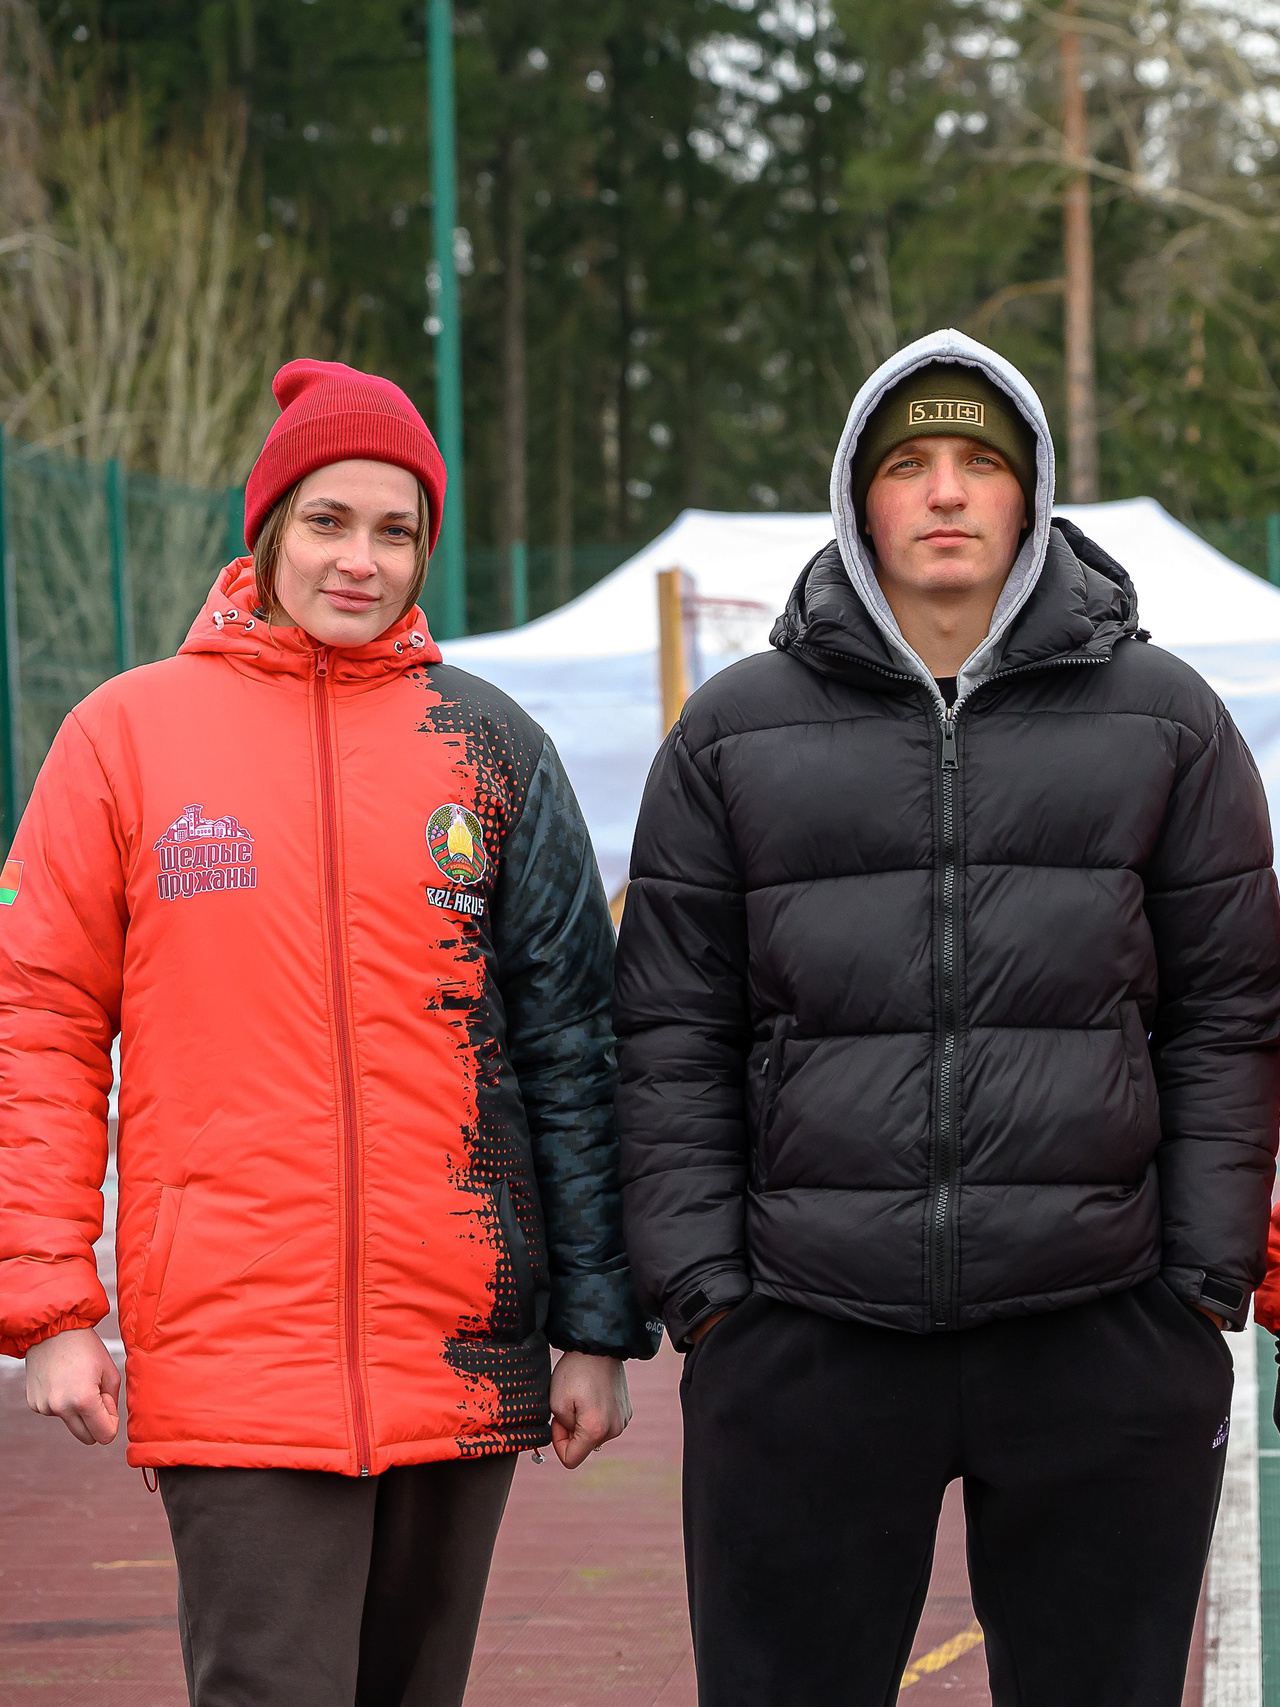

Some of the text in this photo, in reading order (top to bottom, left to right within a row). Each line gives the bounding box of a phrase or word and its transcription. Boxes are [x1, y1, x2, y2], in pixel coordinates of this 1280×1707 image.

[160, 843, 252, 872] Щедрые
[157, 867, 257, 901] Пружаны
[426, 887, 485, 916] BELARUS
